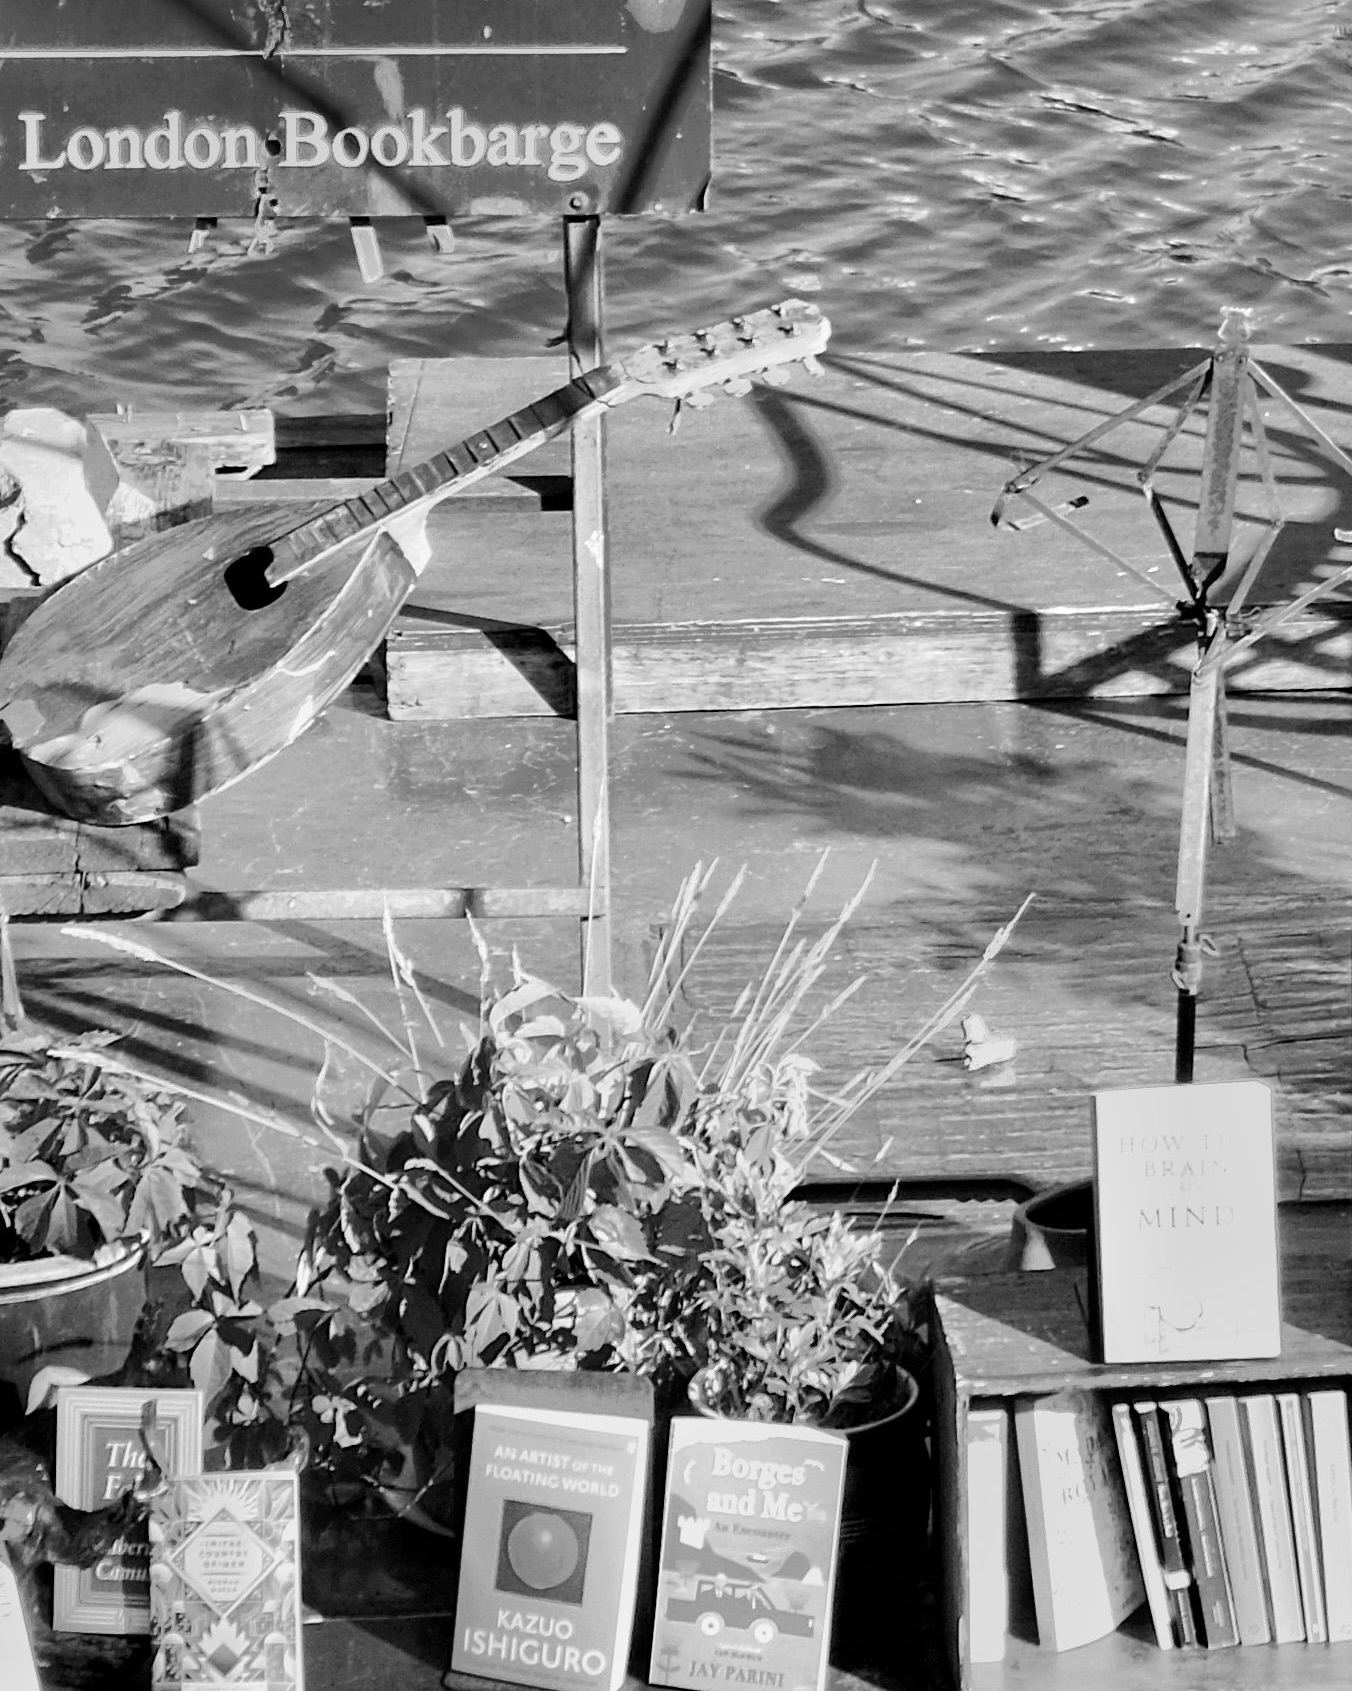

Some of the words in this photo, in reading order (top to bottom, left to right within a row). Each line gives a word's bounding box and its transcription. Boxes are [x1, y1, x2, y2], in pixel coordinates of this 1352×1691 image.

[19, 112, 259, 172] London
[270, 108, 624, 183] Bookbarge
[1120, 1134, 1185, 1154] HOW
[494, 1445, 517, 1461] AN
[518, 1447, 572, 1470] ARTIST
[591, 1462, 615, 1476] THE
[711, 1447, 807, 1490] Borges
[485, 1464, 561, 1490] FLOATING
[562, 1477, 620, 1498] WORLD
[706, 1488, 757, 1518] and
[760, 1490, 804, 1523] Me
[497, 1610, 574, 1641] KAZUO
[463, 1628, 607, 1676] ISHIGURO
[689, 1660, 721, 1680] JAY
[725, 1663, 785, 1688] PARINI
